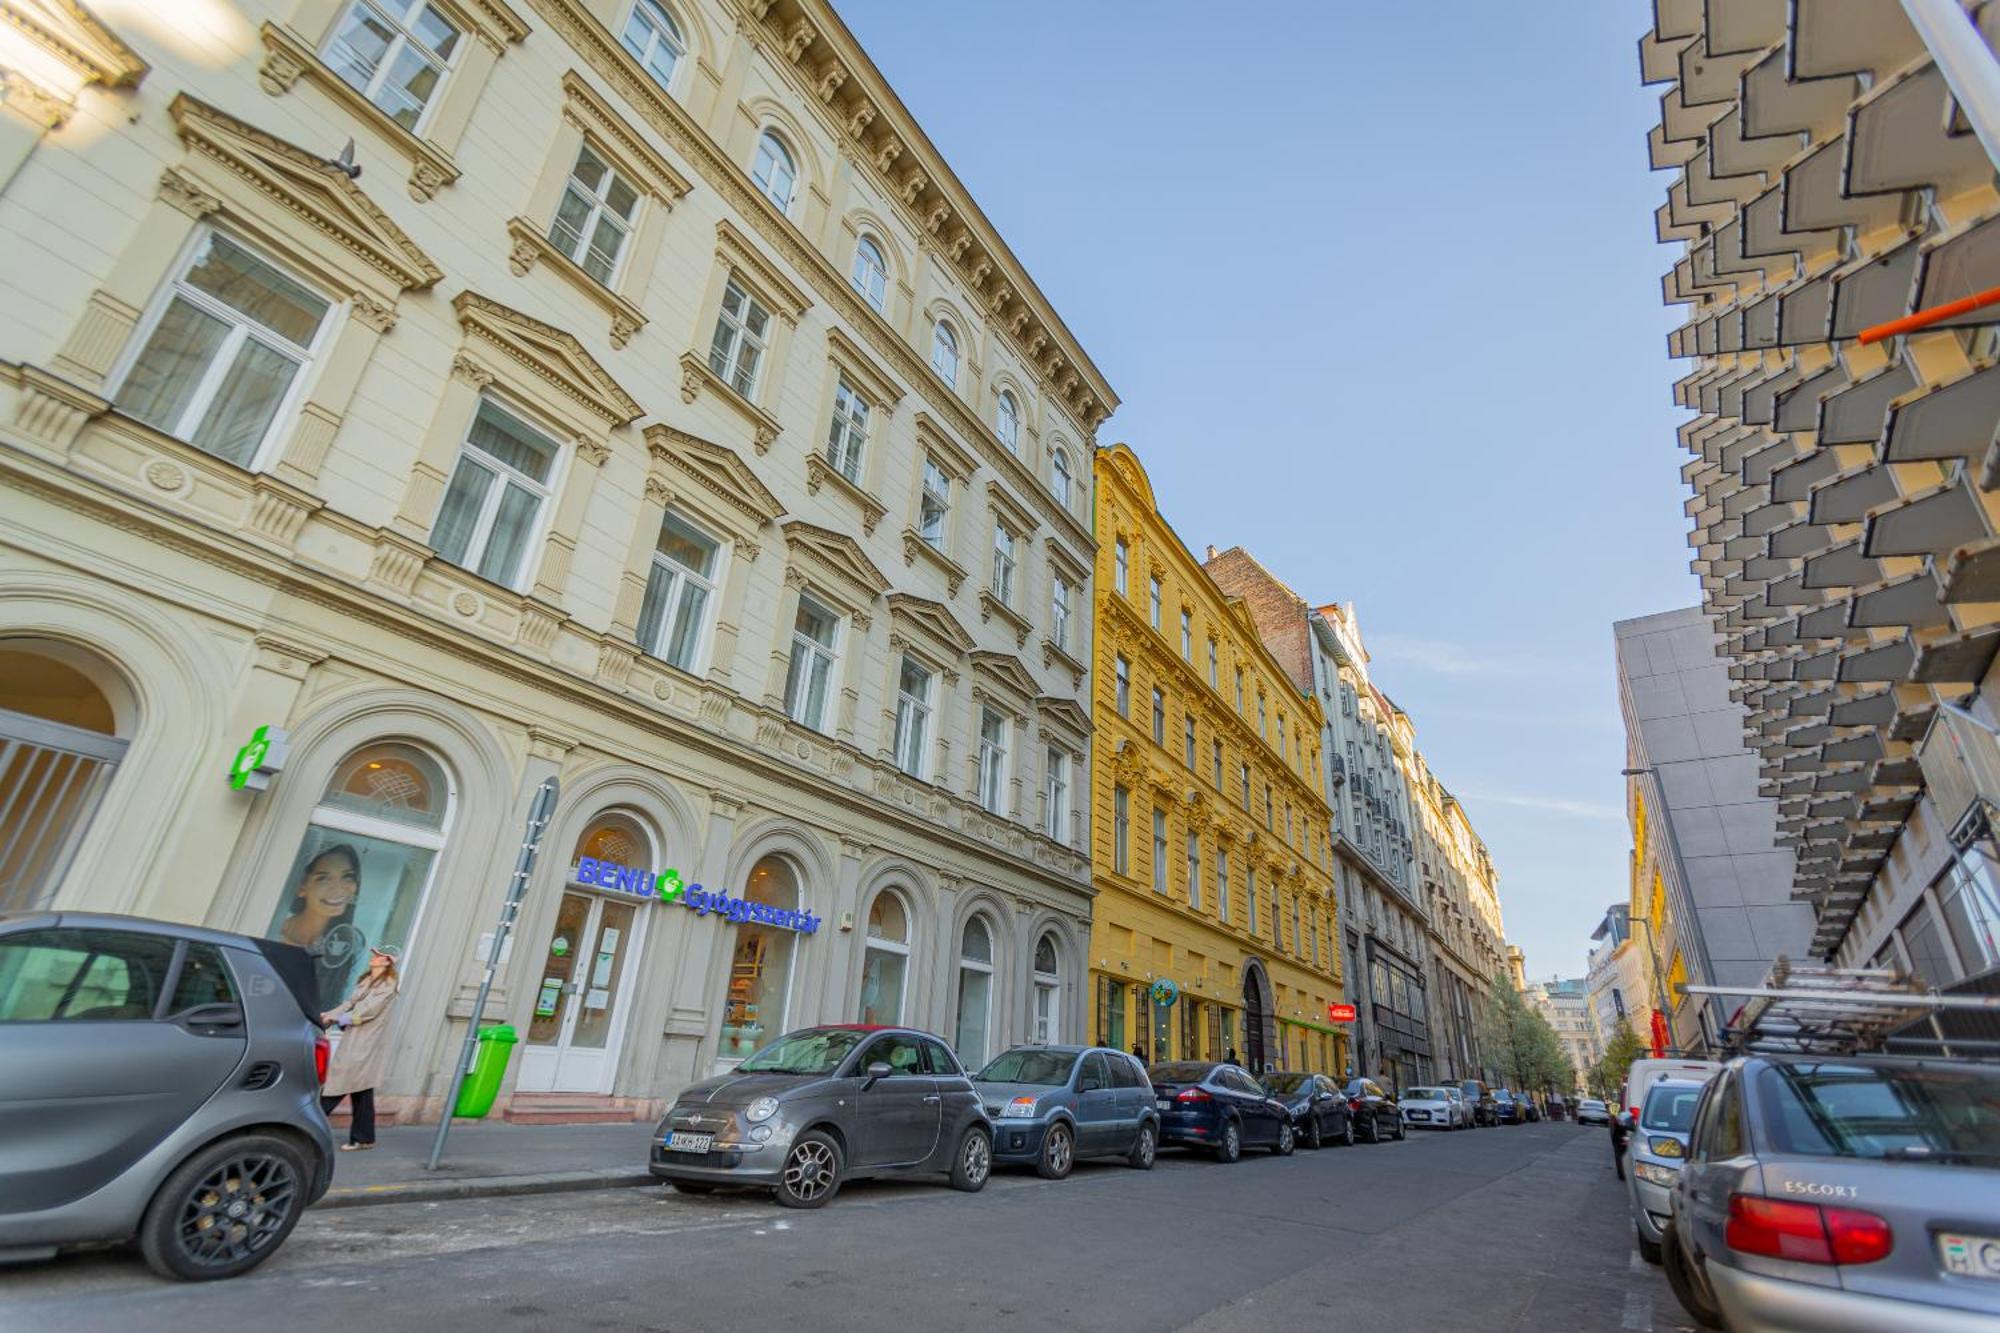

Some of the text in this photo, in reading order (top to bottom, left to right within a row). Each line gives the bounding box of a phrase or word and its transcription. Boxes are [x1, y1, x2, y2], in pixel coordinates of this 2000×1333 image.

[576, 856, 822, 934] BENU Gyógyszertár
[1784, 1180, 1857, 1198] ESCORT
